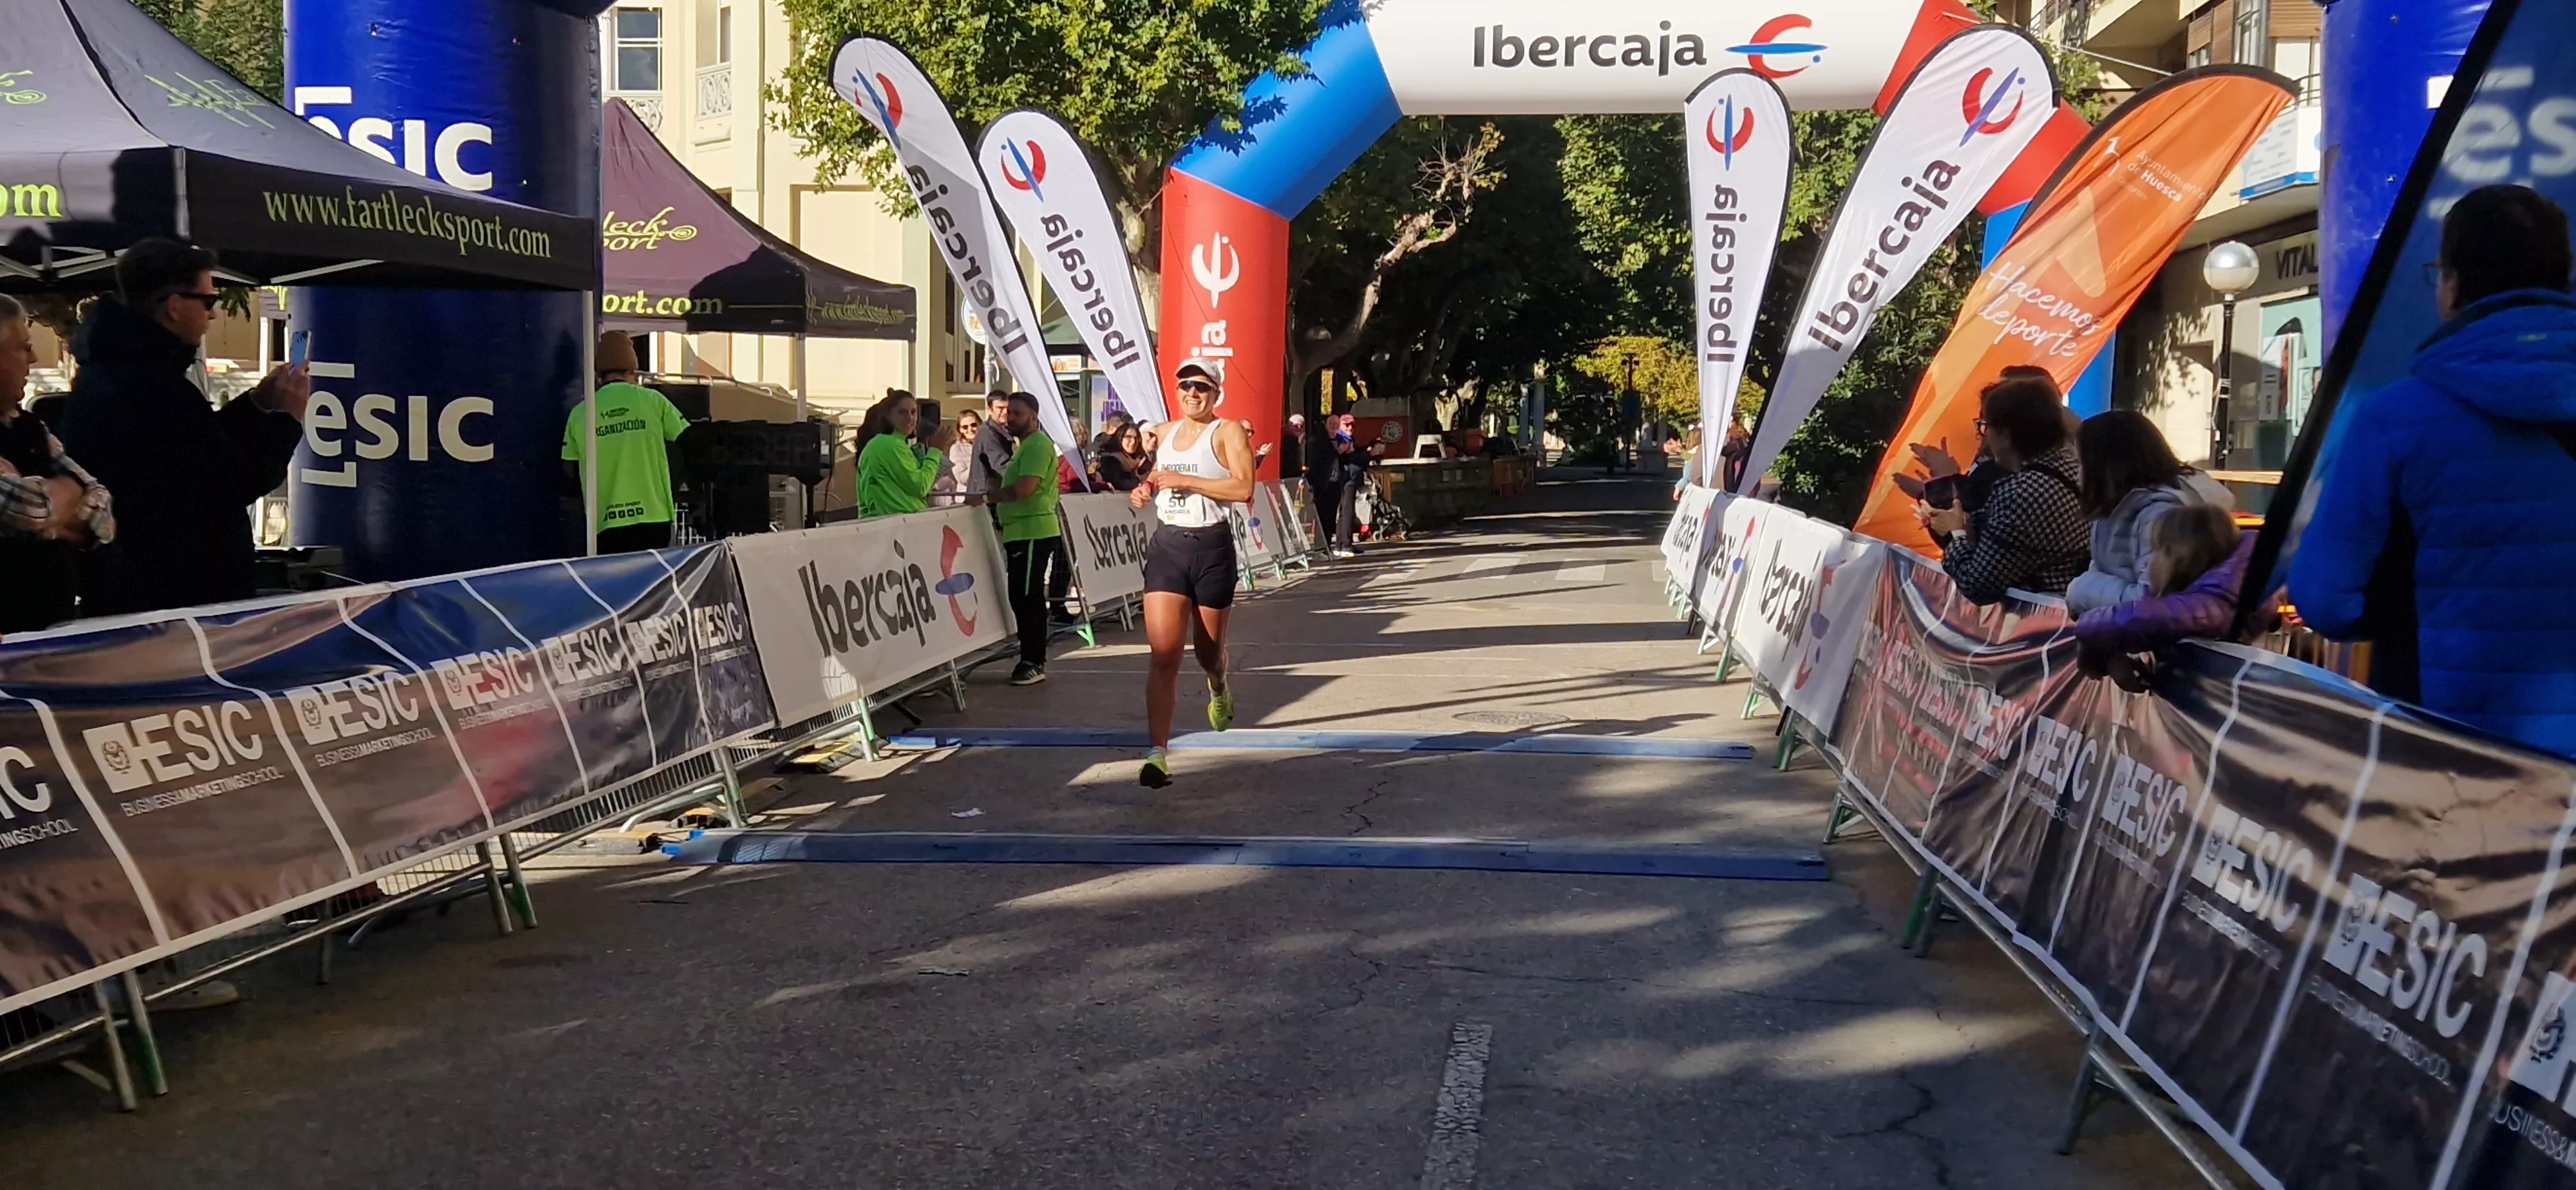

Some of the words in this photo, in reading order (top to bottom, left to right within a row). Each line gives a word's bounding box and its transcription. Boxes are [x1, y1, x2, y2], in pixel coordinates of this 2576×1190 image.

[1473, 20, 1707, 76] Ibercaja
[263, 185, 552, 258] www.fartlecksport.com
[2140, 169, 2183, 202] Huesca
[1808, 159, 1962, 352] Ibercaja
[1986, 261, 2101, 336] Hacemos
[797, 539, 936, 657] Ibercaja
[455, 647, 535, 704] ESIC
[560, 627, 622, 681] ESIC
[130, 700, 264, 784] ESIC
[319, 671, 419, 739] ESIC
[2040, 721, 2098, 803] ESIC
[0, 819, 79, 849] INGSCHOOL
[2118, 762, 2188, 858] ESIC
[2214, 816, 2315, 932] ESIC
[2355, 890, 2487, 1038] ESIC
